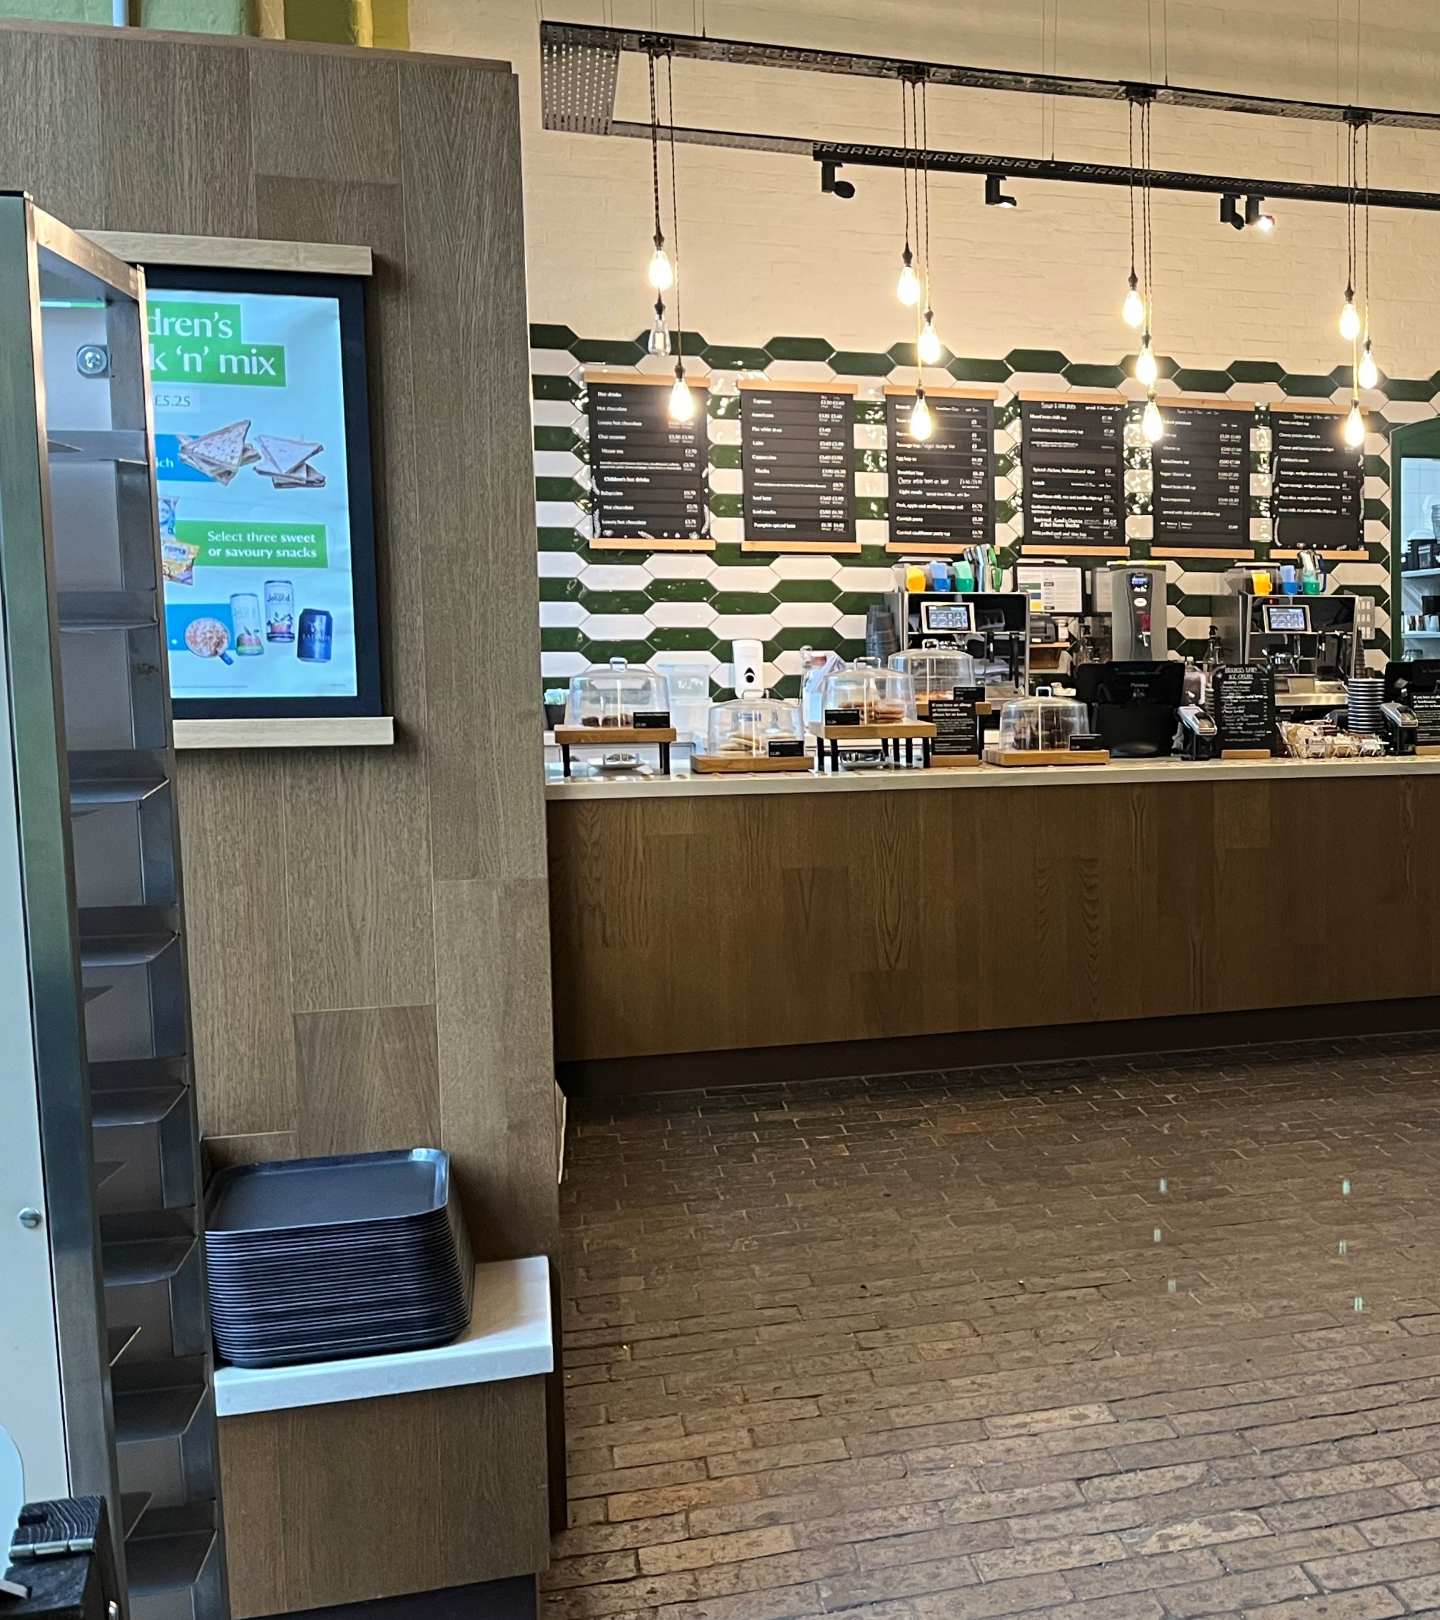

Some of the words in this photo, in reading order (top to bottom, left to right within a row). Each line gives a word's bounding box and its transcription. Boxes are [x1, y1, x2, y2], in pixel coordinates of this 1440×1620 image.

[148, 308, 234, 339] dren's
[219, 348, 277, 376] mix
[154, 394, 191, 407] £5.25
[207, 531, 243, 543] Select
[247, 532, 277, 544] three
[281, 534, 316, 544] sweet
[208, 547, 221, 557] or
[225, 547, 272, 560] savoury
[276, 548, 317, 559] snacks
